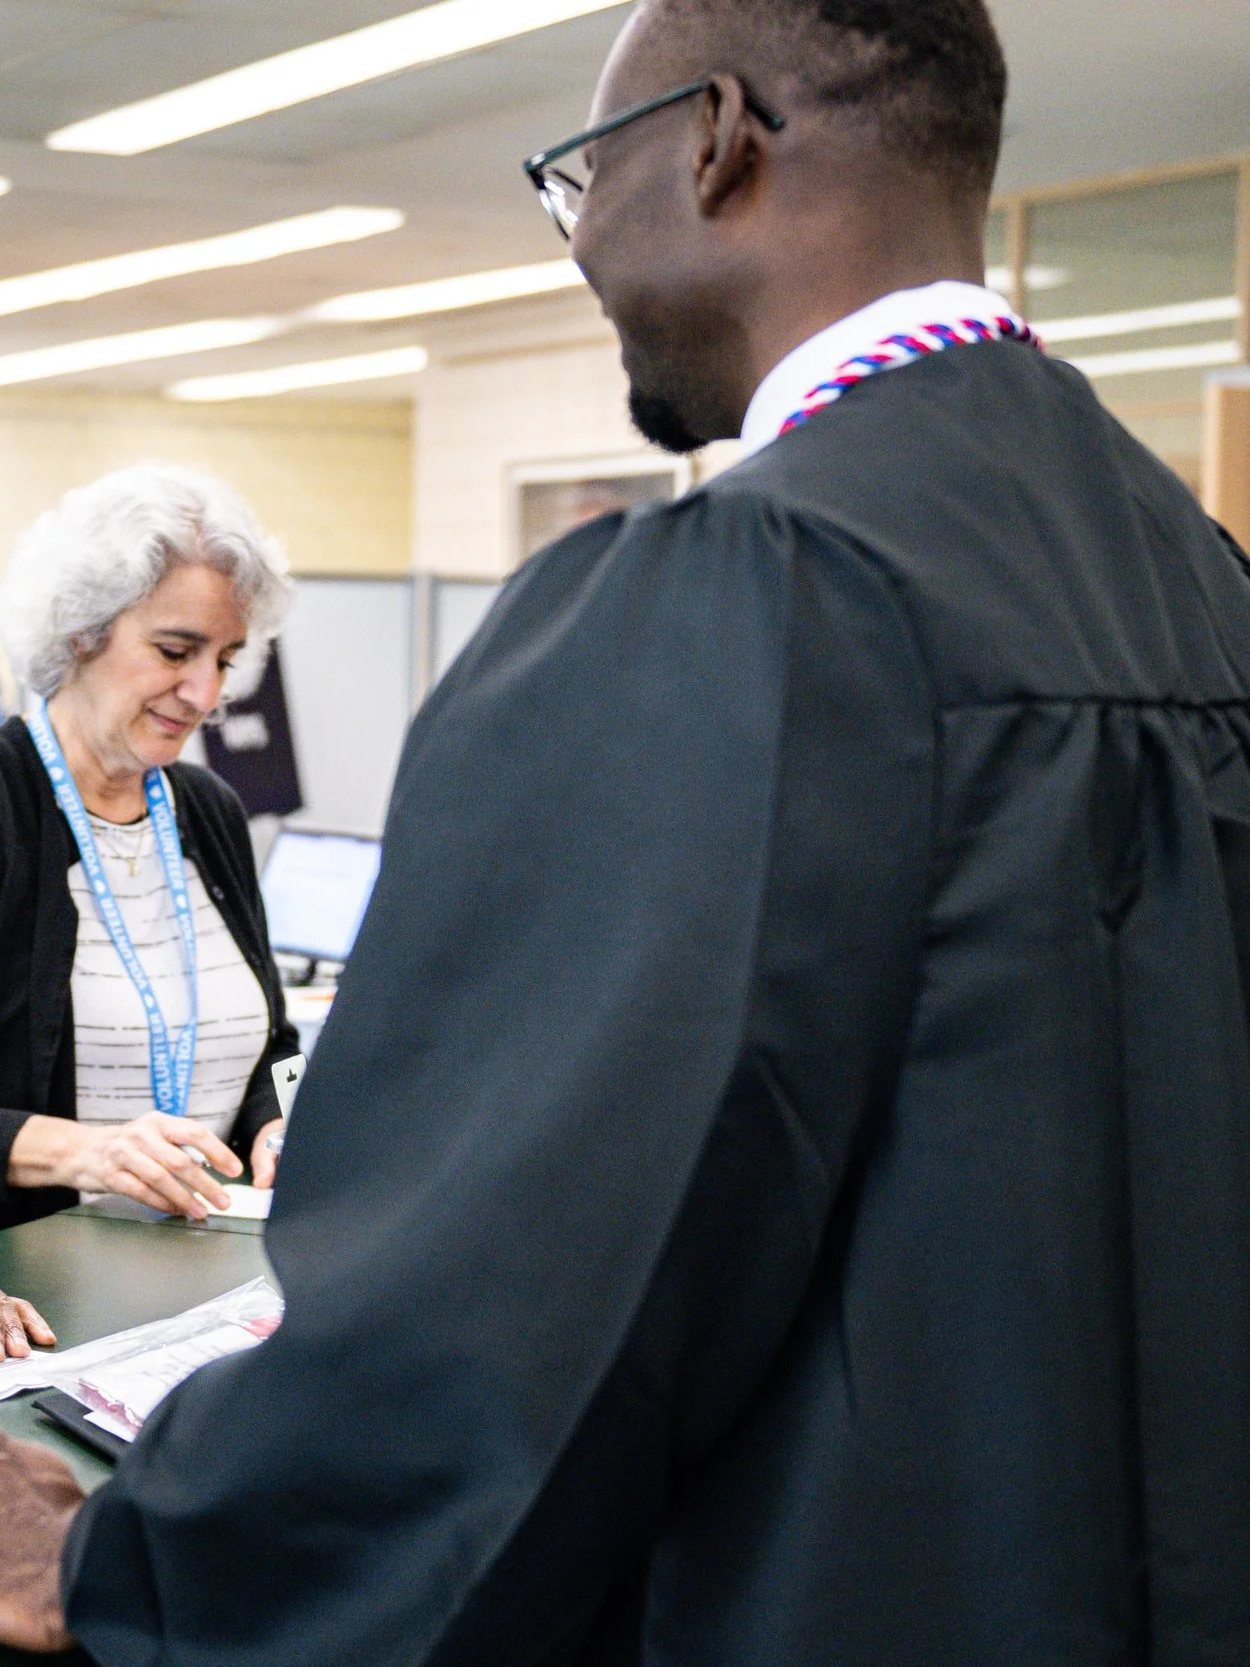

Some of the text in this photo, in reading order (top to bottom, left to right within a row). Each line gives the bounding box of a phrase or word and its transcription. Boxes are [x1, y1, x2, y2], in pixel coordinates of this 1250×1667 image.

[57, 783, 99, 874] VOLUNTEER
[153, 801, 184, 890] VOLUNTEER
[100, 898, 147, 989] VOLUNTEER
[150, 1013, 173, 1110] VOLUNTEER
